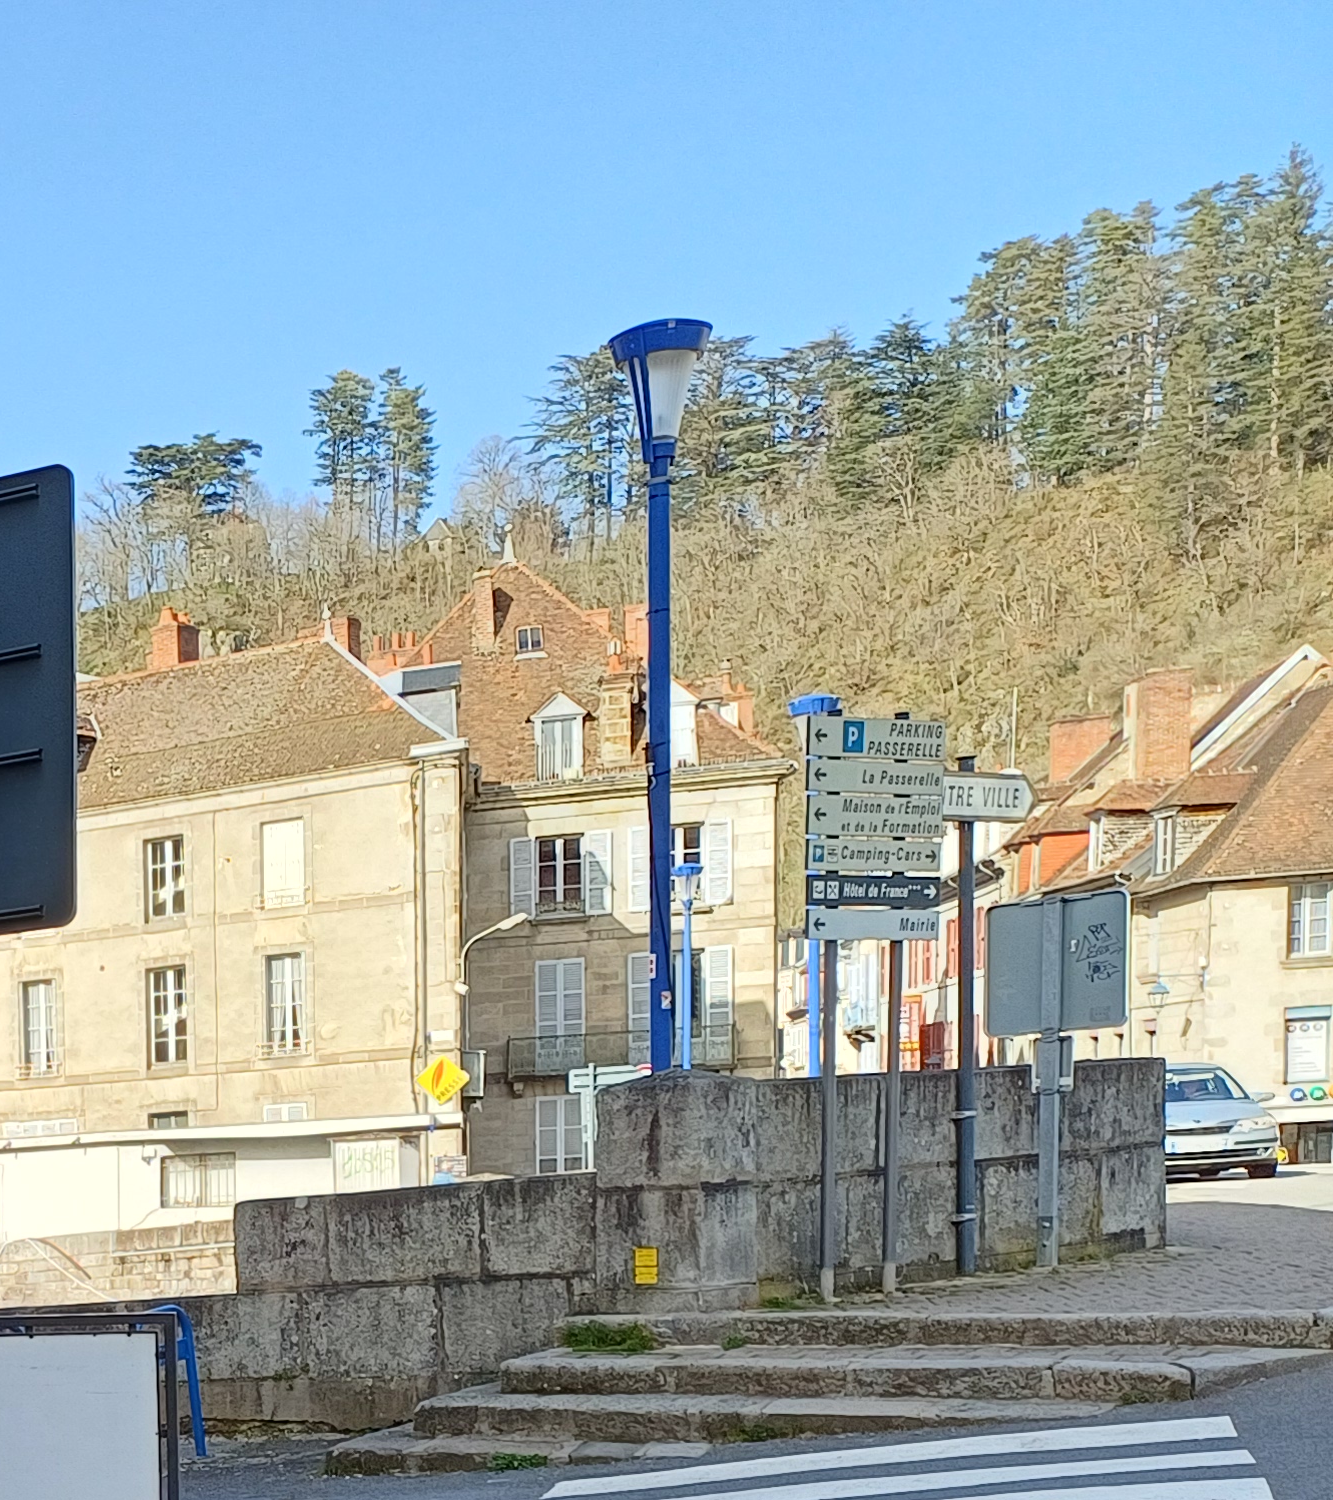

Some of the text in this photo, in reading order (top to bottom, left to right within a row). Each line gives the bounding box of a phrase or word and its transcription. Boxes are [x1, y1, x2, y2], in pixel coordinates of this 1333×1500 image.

[889, 722, 943, 739] PARKING
[867, 740, 942, 758] PASSERELLE
[862, 769, 940, 786] La Passerelle
[943, 785, 1019, 808] TRE VILLE
[842, 798, 881, 814] Maison
[885, 803, 895, 815] de
[841, 819, 940, 834] et de la Formation
[841, 846, 922, 864] Camping-Cars
[843, 881, 866, 898] Hôtel
[868, 885, 879, 898] de
[899, 917, 935, 932] Mairie
